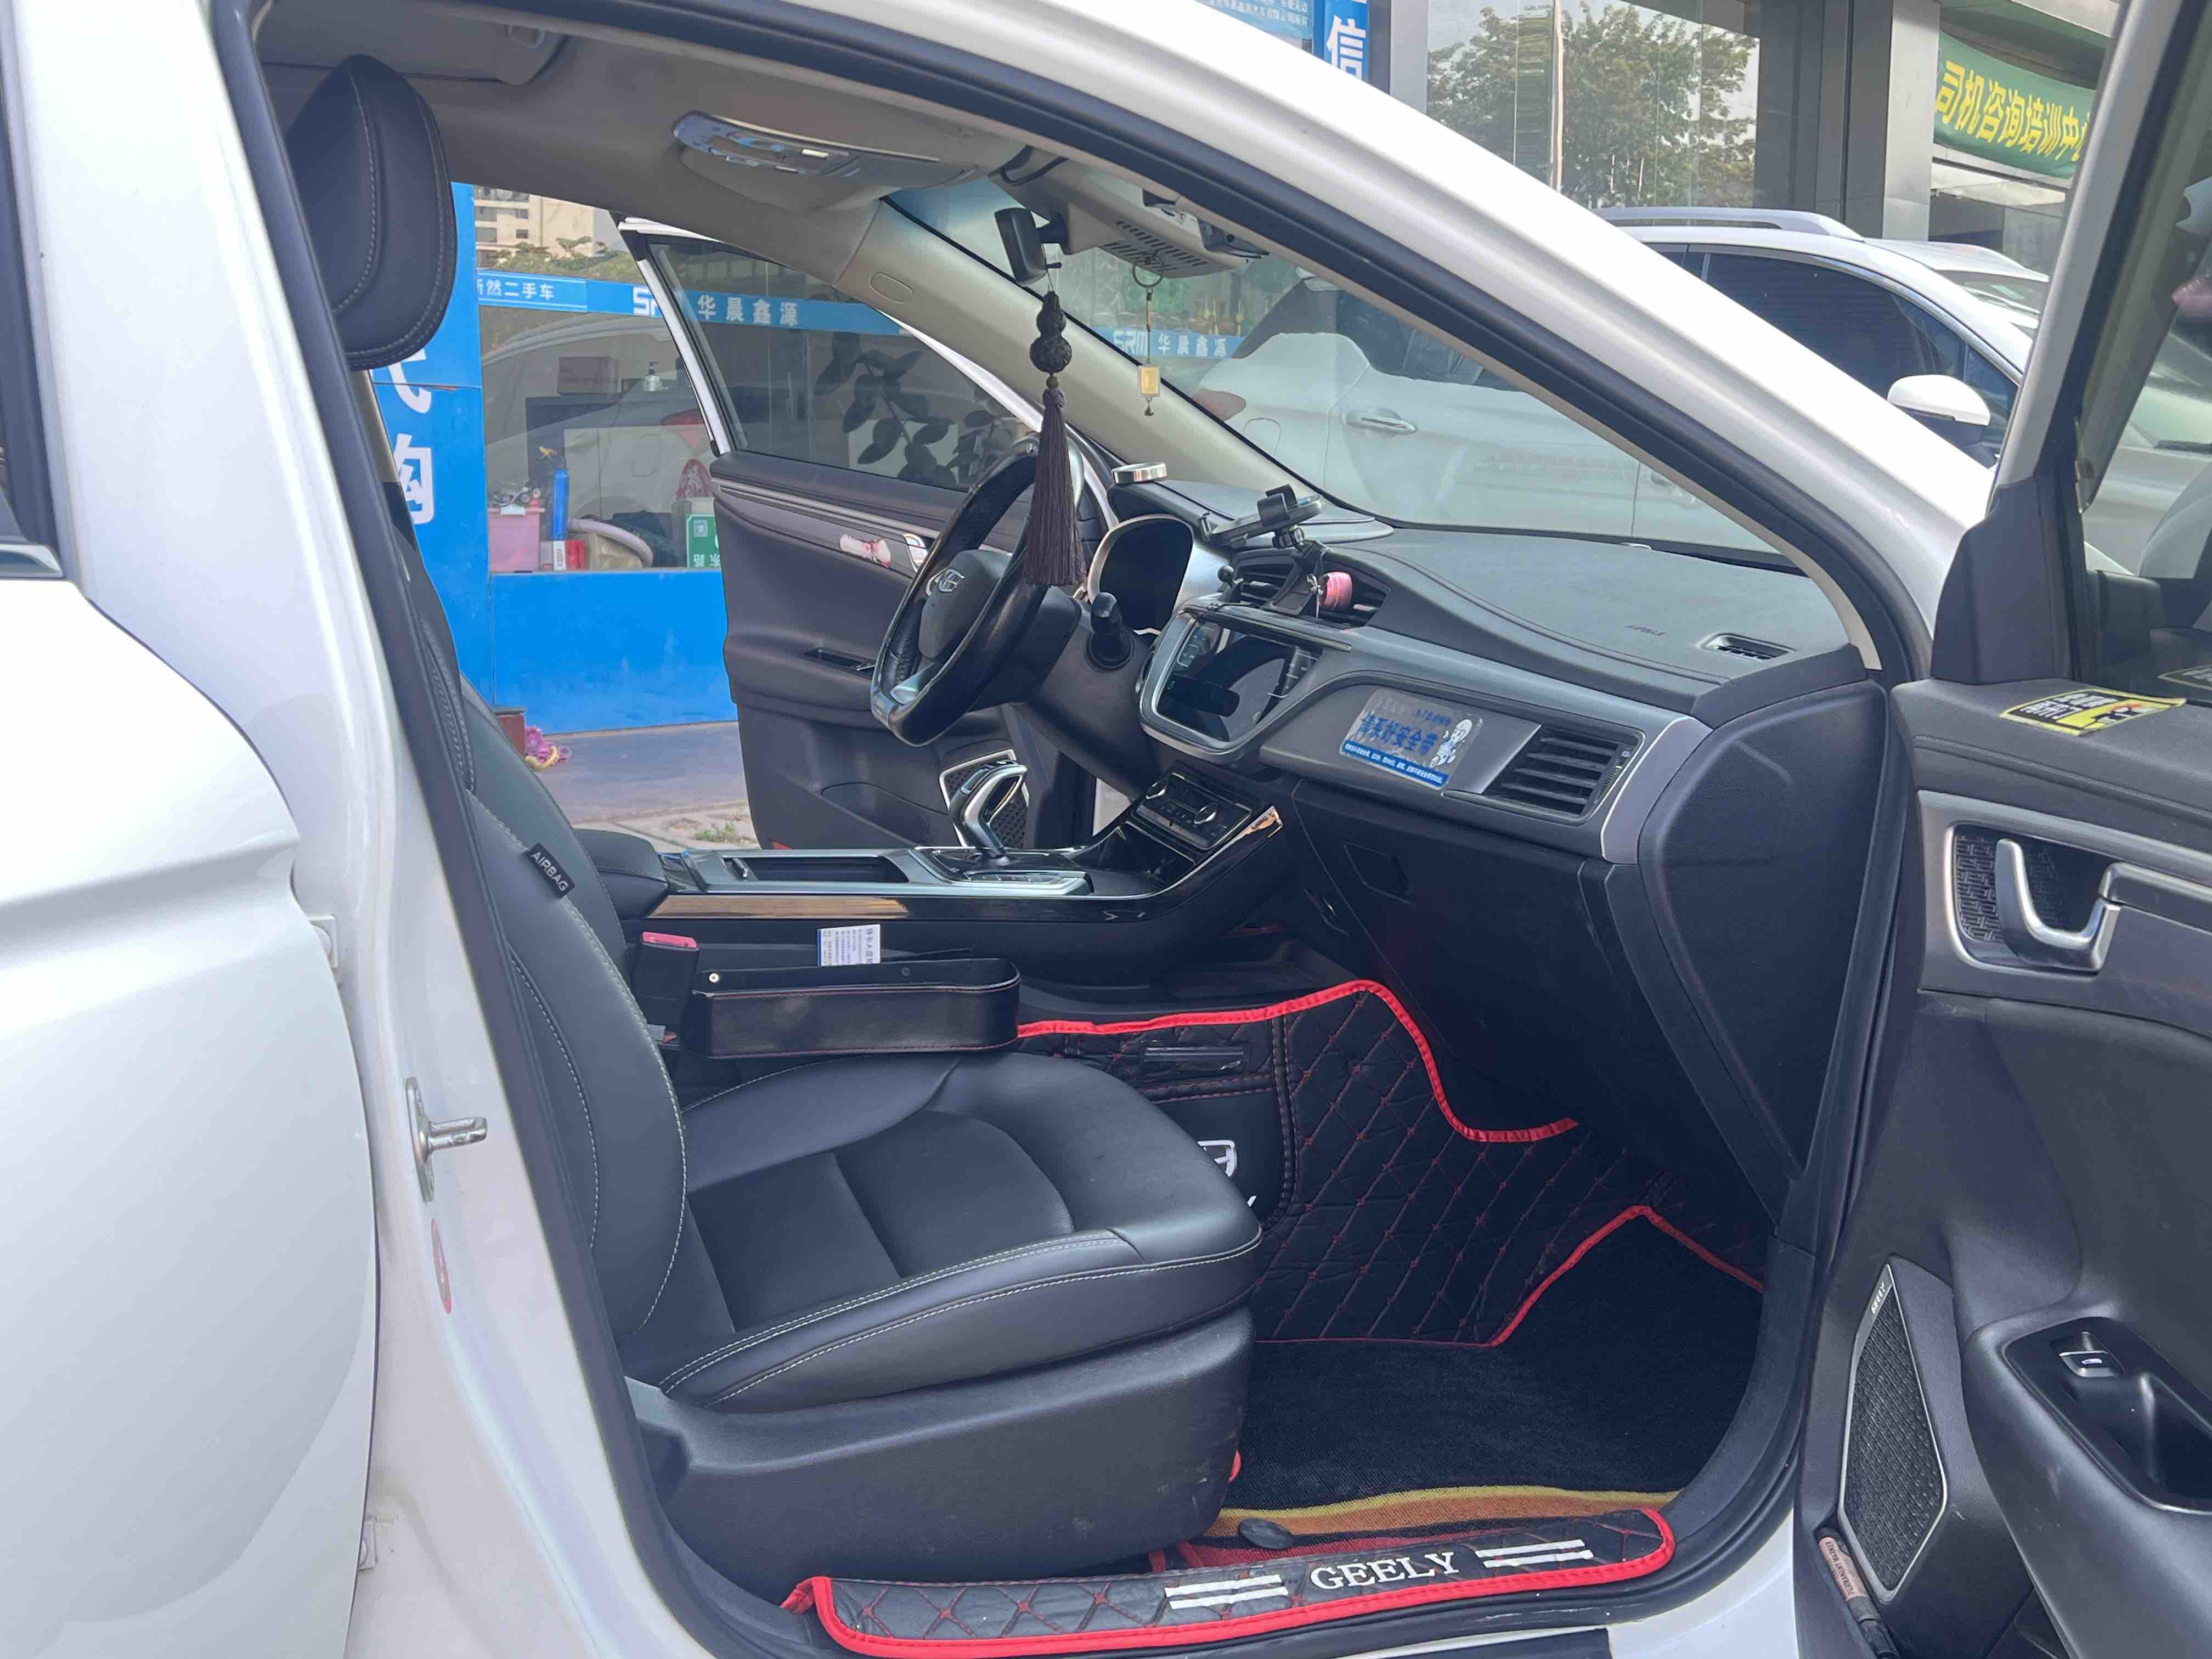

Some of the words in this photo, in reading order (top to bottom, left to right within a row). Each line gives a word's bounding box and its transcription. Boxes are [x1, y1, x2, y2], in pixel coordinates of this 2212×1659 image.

[697, 294, 798, 327] 华晨鑫源
[531, 851, 568, 891] AIRBAG
[1310, 1551, 1459, 1589] GEELY
